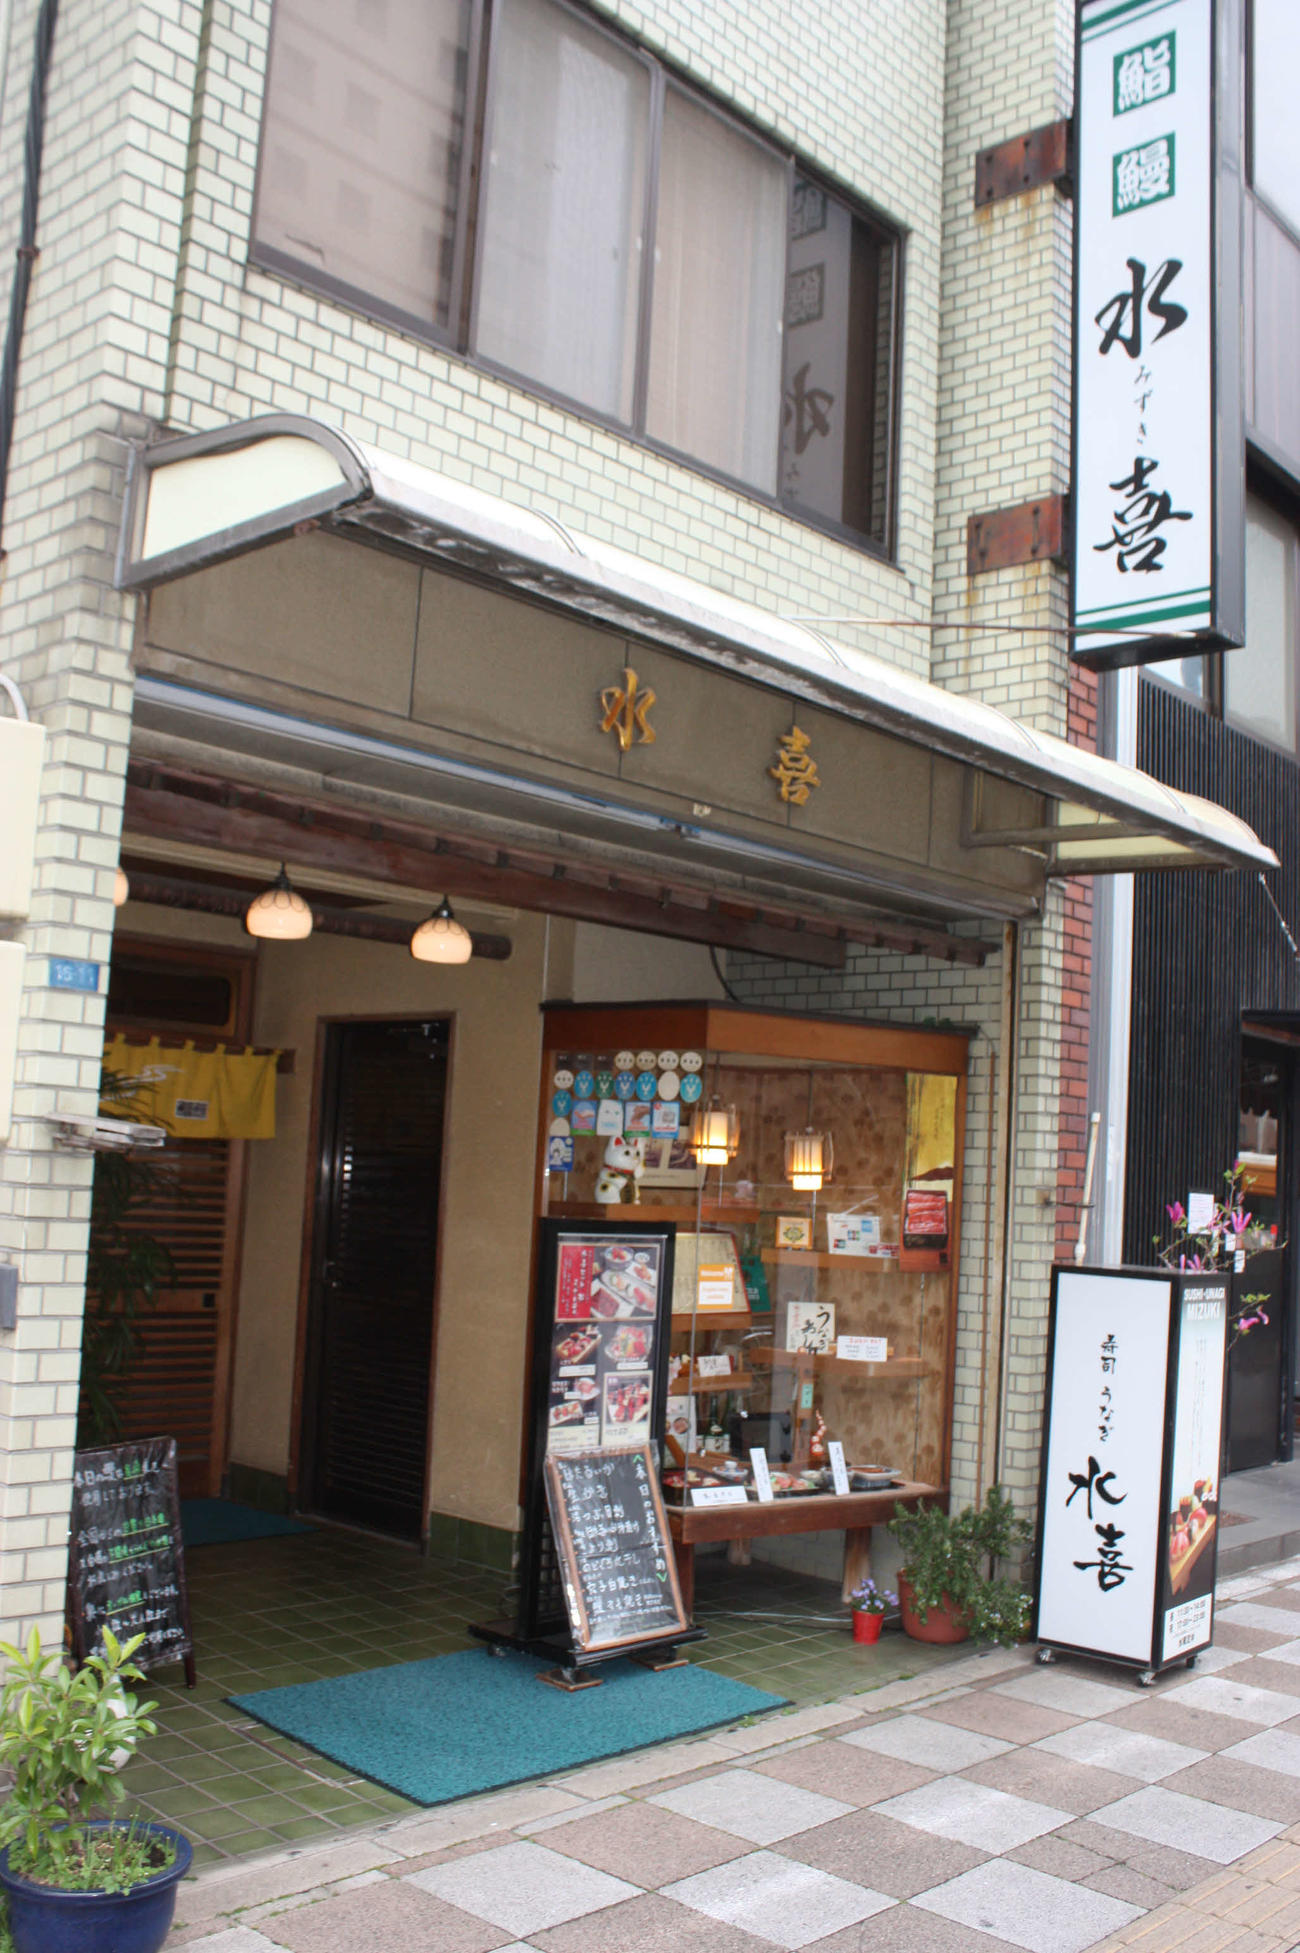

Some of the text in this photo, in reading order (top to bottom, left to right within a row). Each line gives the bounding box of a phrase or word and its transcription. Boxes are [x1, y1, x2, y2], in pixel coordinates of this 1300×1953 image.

[1118, 39, 1170, 112] 鮨
[1117, 139, 1170, 210] 鰻
[1094, 258, 1188, 358] 水
[1093, 456, 1193, 574] 喜
[1187, 1302, 1220, 1320] MIZUKI
[1098, 1334, 1118, 1442] 寿司 うなぎ
